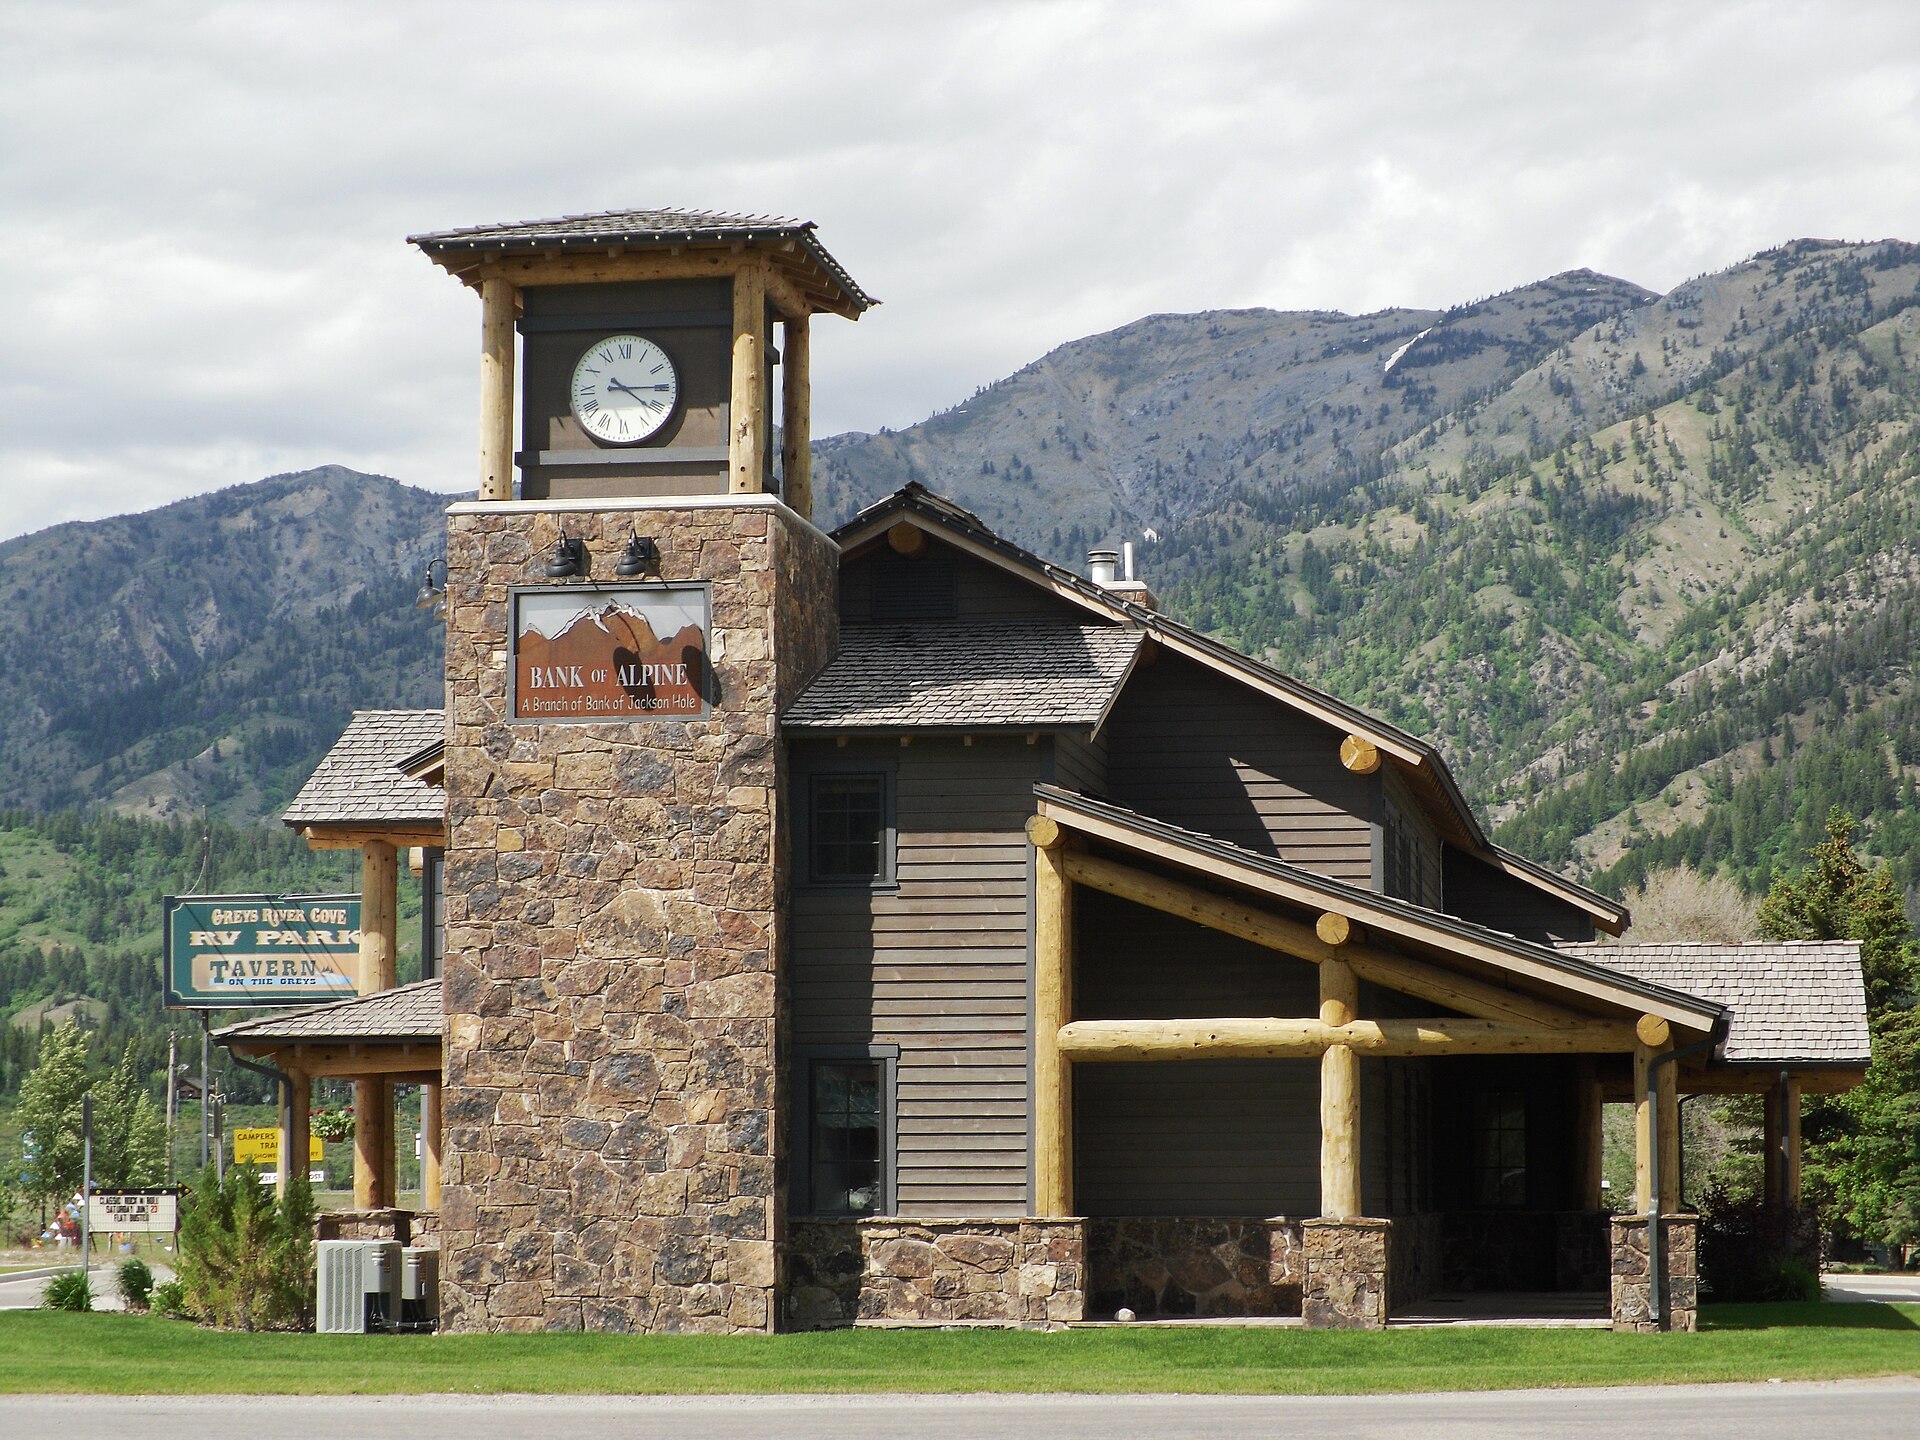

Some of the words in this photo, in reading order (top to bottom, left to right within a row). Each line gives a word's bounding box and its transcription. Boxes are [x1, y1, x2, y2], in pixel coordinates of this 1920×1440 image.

[530, 665, 584, 689] BANK
[591, 669, 608, 683] OF
[616, 663, 688, 687] ALPINE
[522, 698, 530, 711] A
[533, 695, 568, 711] Branch
[571, 694, 583, 711] of
[586, 695, 610, 711] Bank
[613, 694, 624, 710] of
[628, 694, 669, 709] Jackson
[672, 693, 696, 708] Hole
[189, 931, 242, 946] RV
[256, 930, 361, 946] PARK
[210, 960, 316, 983] TAVERN
[229, 978, 244, 986] ON
[251, 978, 273, 986] THE
[280, 978, 316, 986] GREYS
[237, 1132, 275, 1141] CAMPERS
